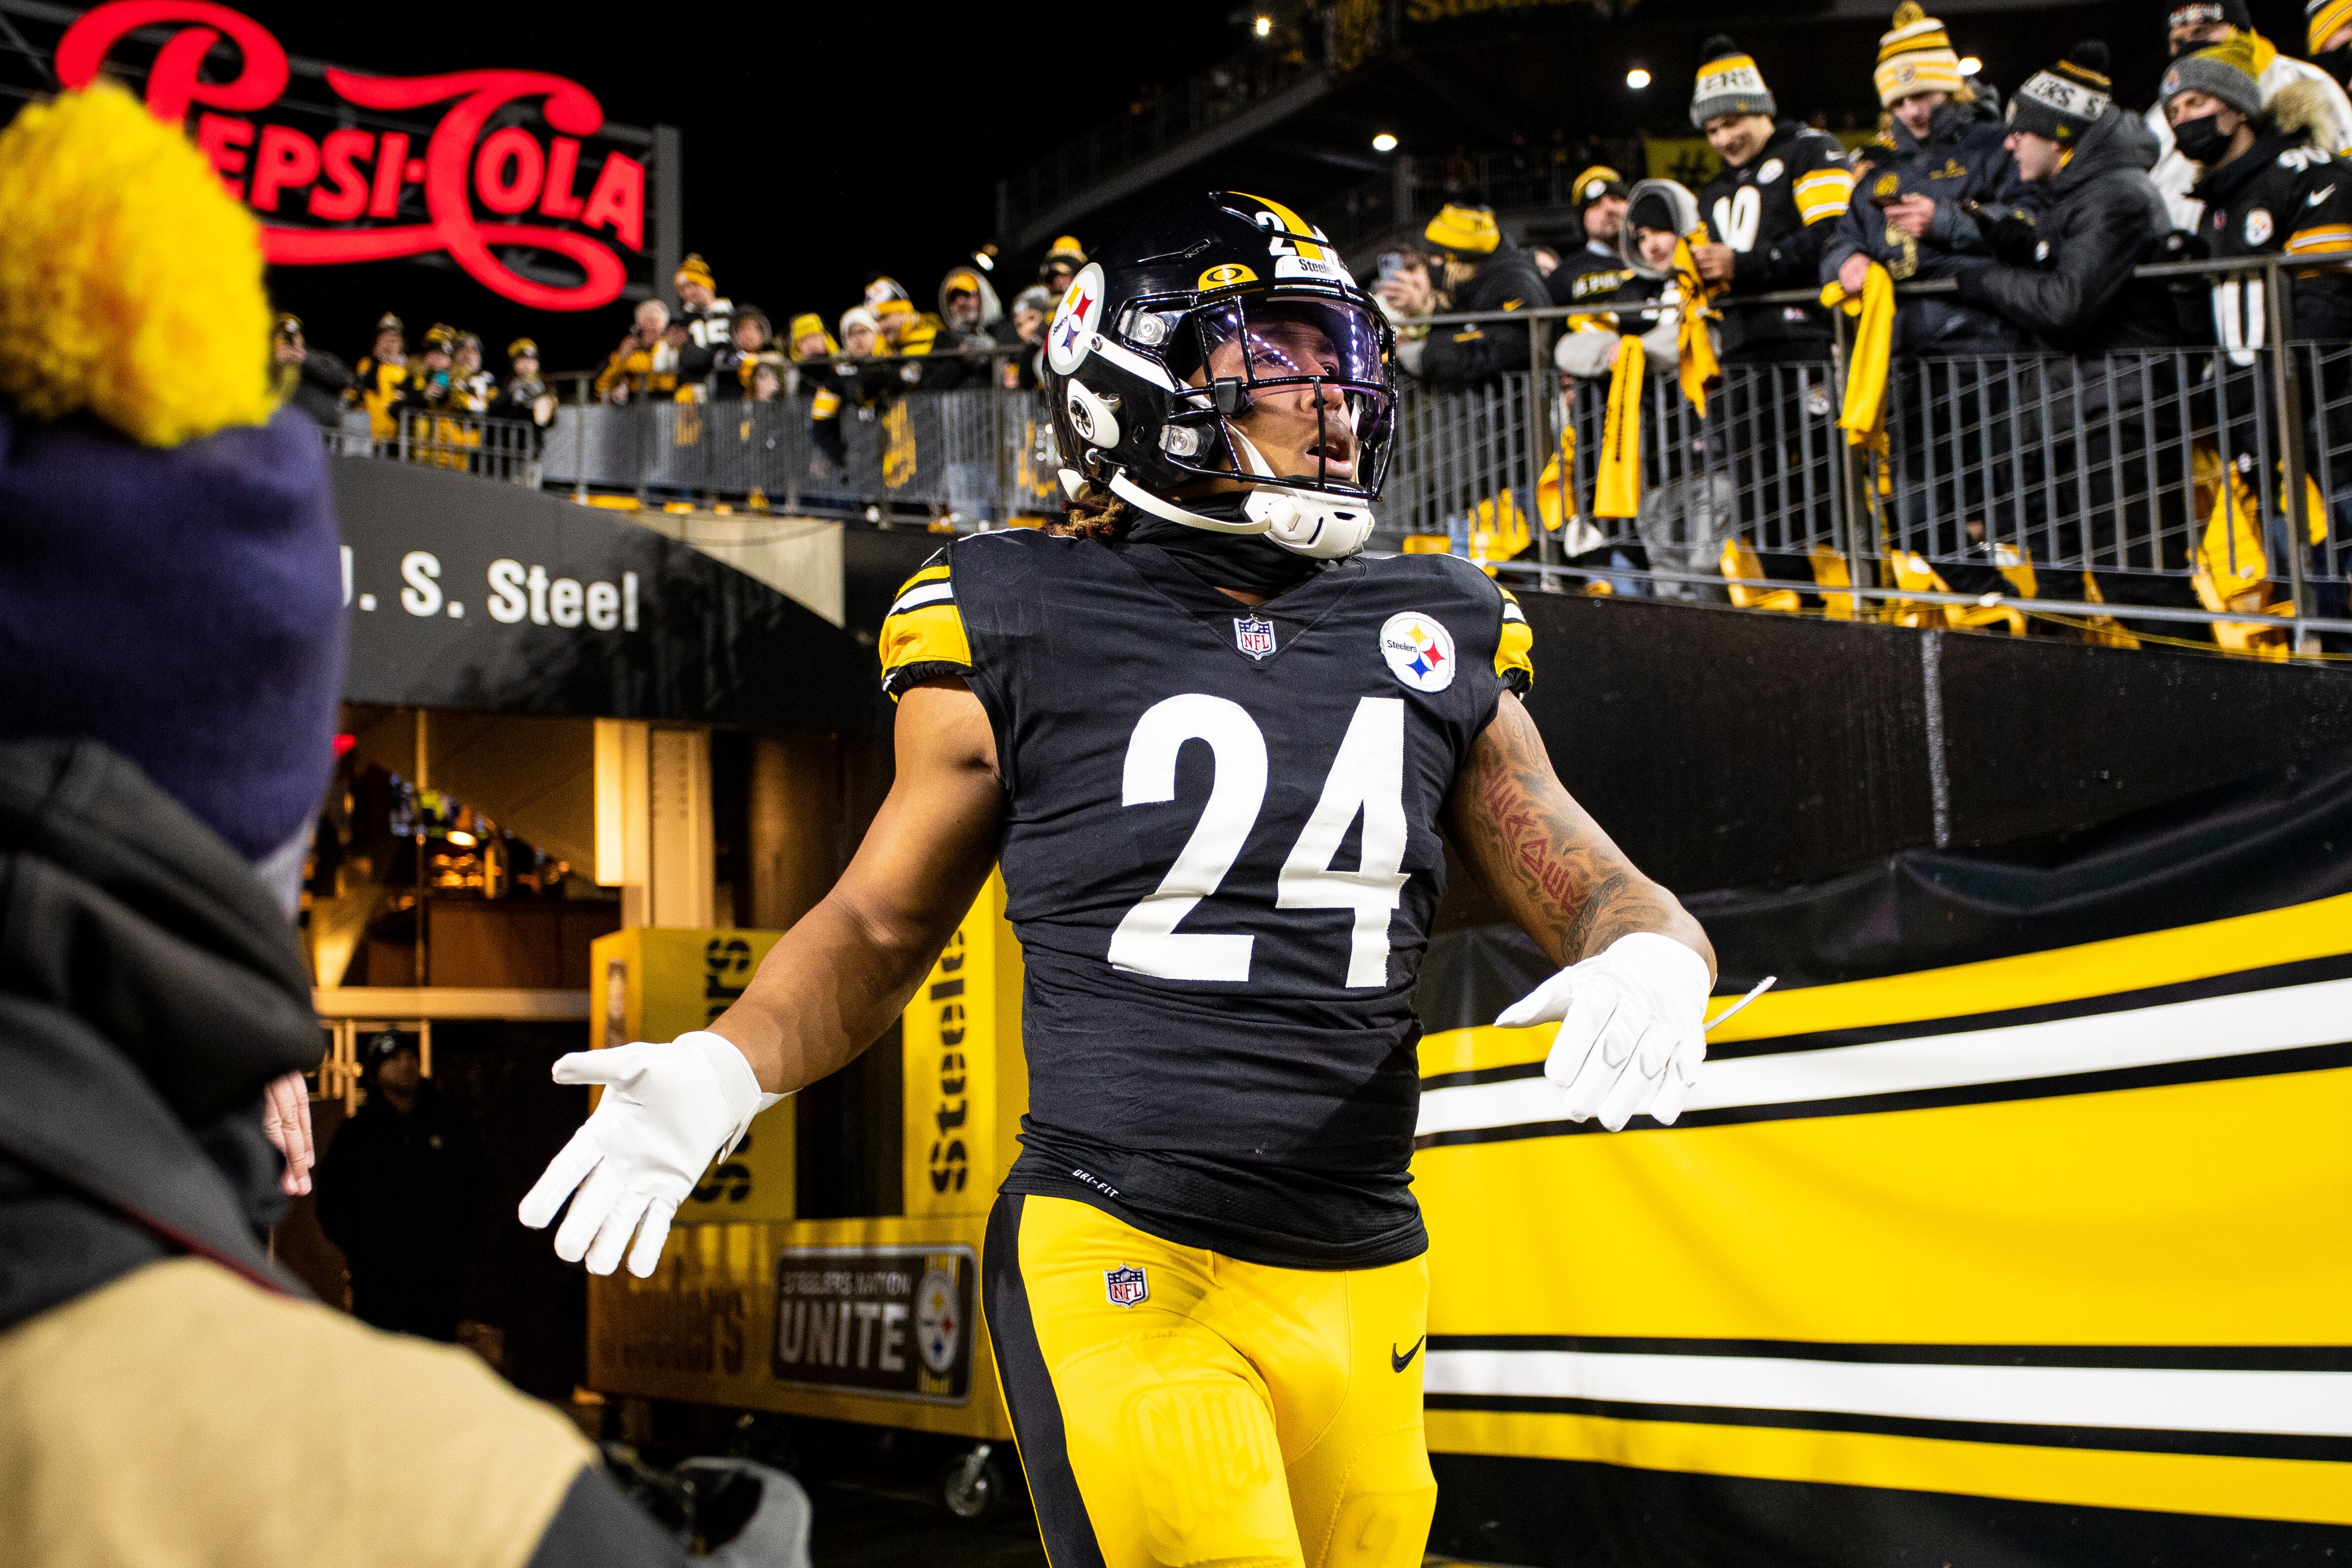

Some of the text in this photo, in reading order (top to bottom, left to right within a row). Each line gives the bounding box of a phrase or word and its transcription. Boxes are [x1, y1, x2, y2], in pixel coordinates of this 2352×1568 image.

[400, 551, 465, 618] S.
[487, 558, 639, 633] Steel
[1243, 634, 1270, 651] NFL
[1387, 640, 1417, 653] Steelers
[1107, 693, 1410, 988] 24
[1073, 1169, 1119, 1198] DRI-FIT
[1112, 1283, 1142, 1301] NFL
[779, 1299, 911, 1373] UNITE
